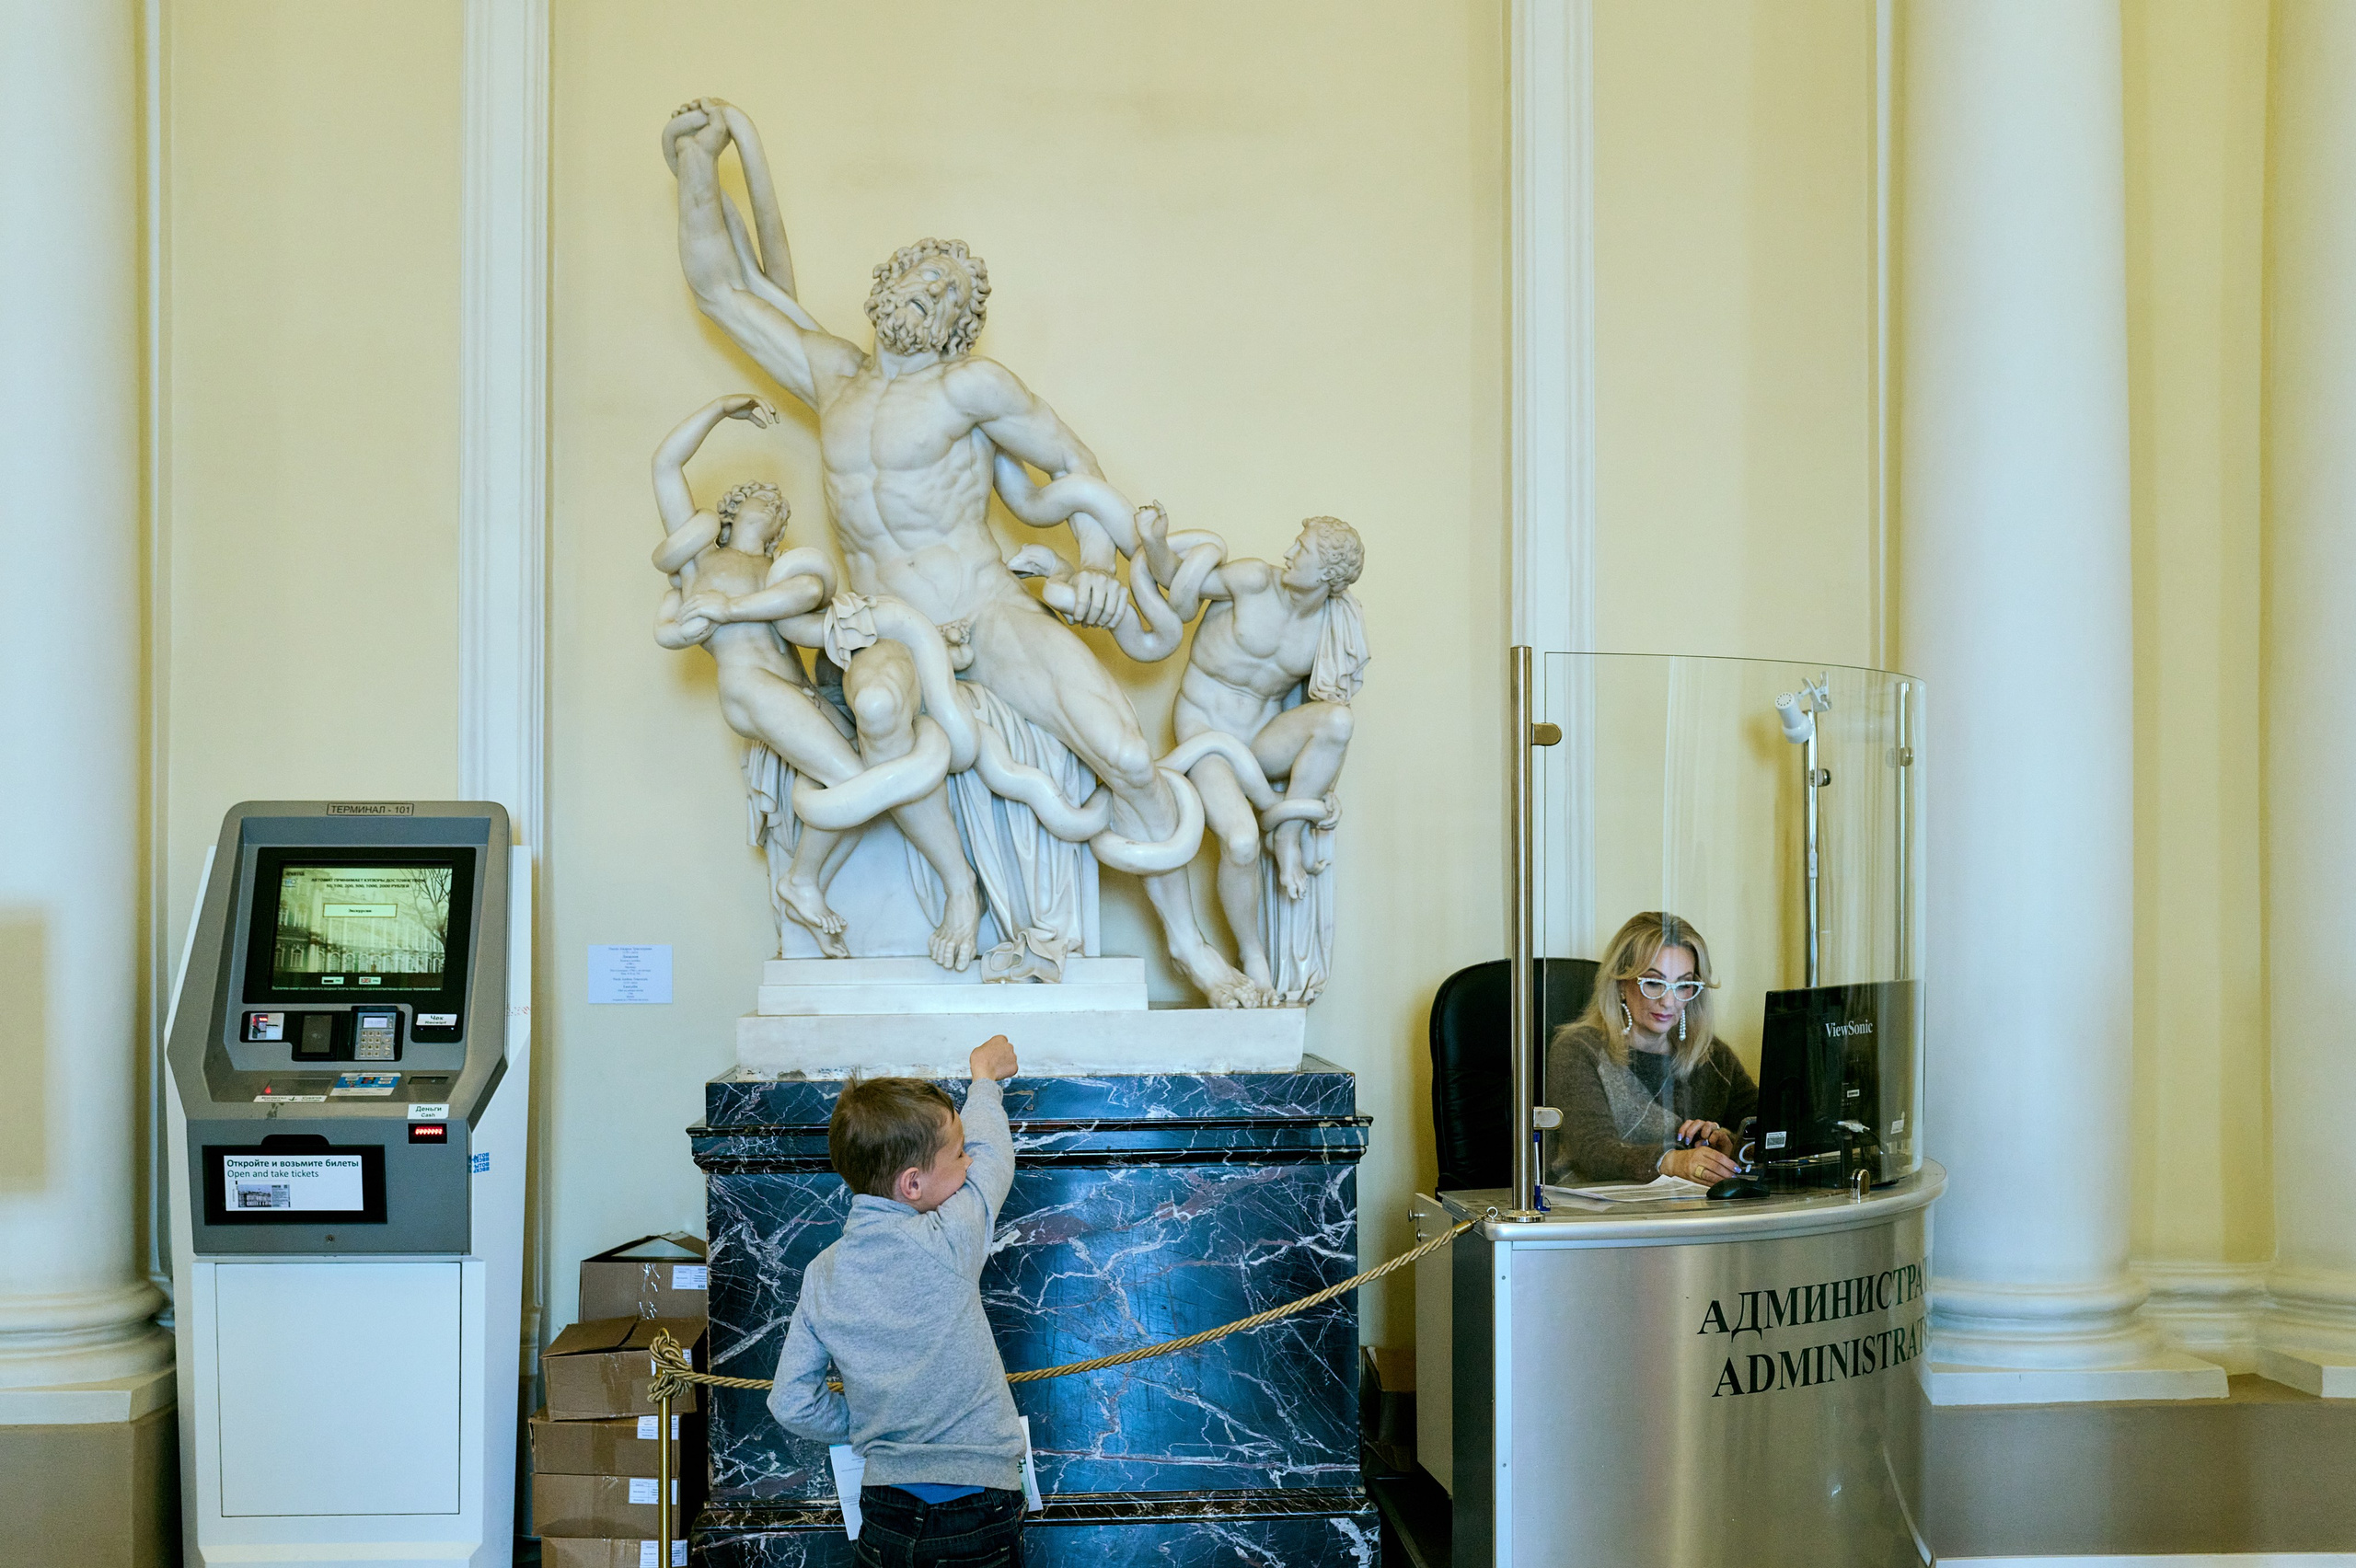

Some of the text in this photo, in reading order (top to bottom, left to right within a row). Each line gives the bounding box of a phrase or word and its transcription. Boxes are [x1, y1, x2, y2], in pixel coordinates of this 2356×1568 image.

[331, 805, 386, 813] ТЕРМИНАЛ
[1825, 1019, 1873, 1038] ViewSonic
[226, 1159, 270, 1169] Откройте
[325, 1159, 359, 1168] билеты
[227, 1170, 319, 1179] Open and take tickets
